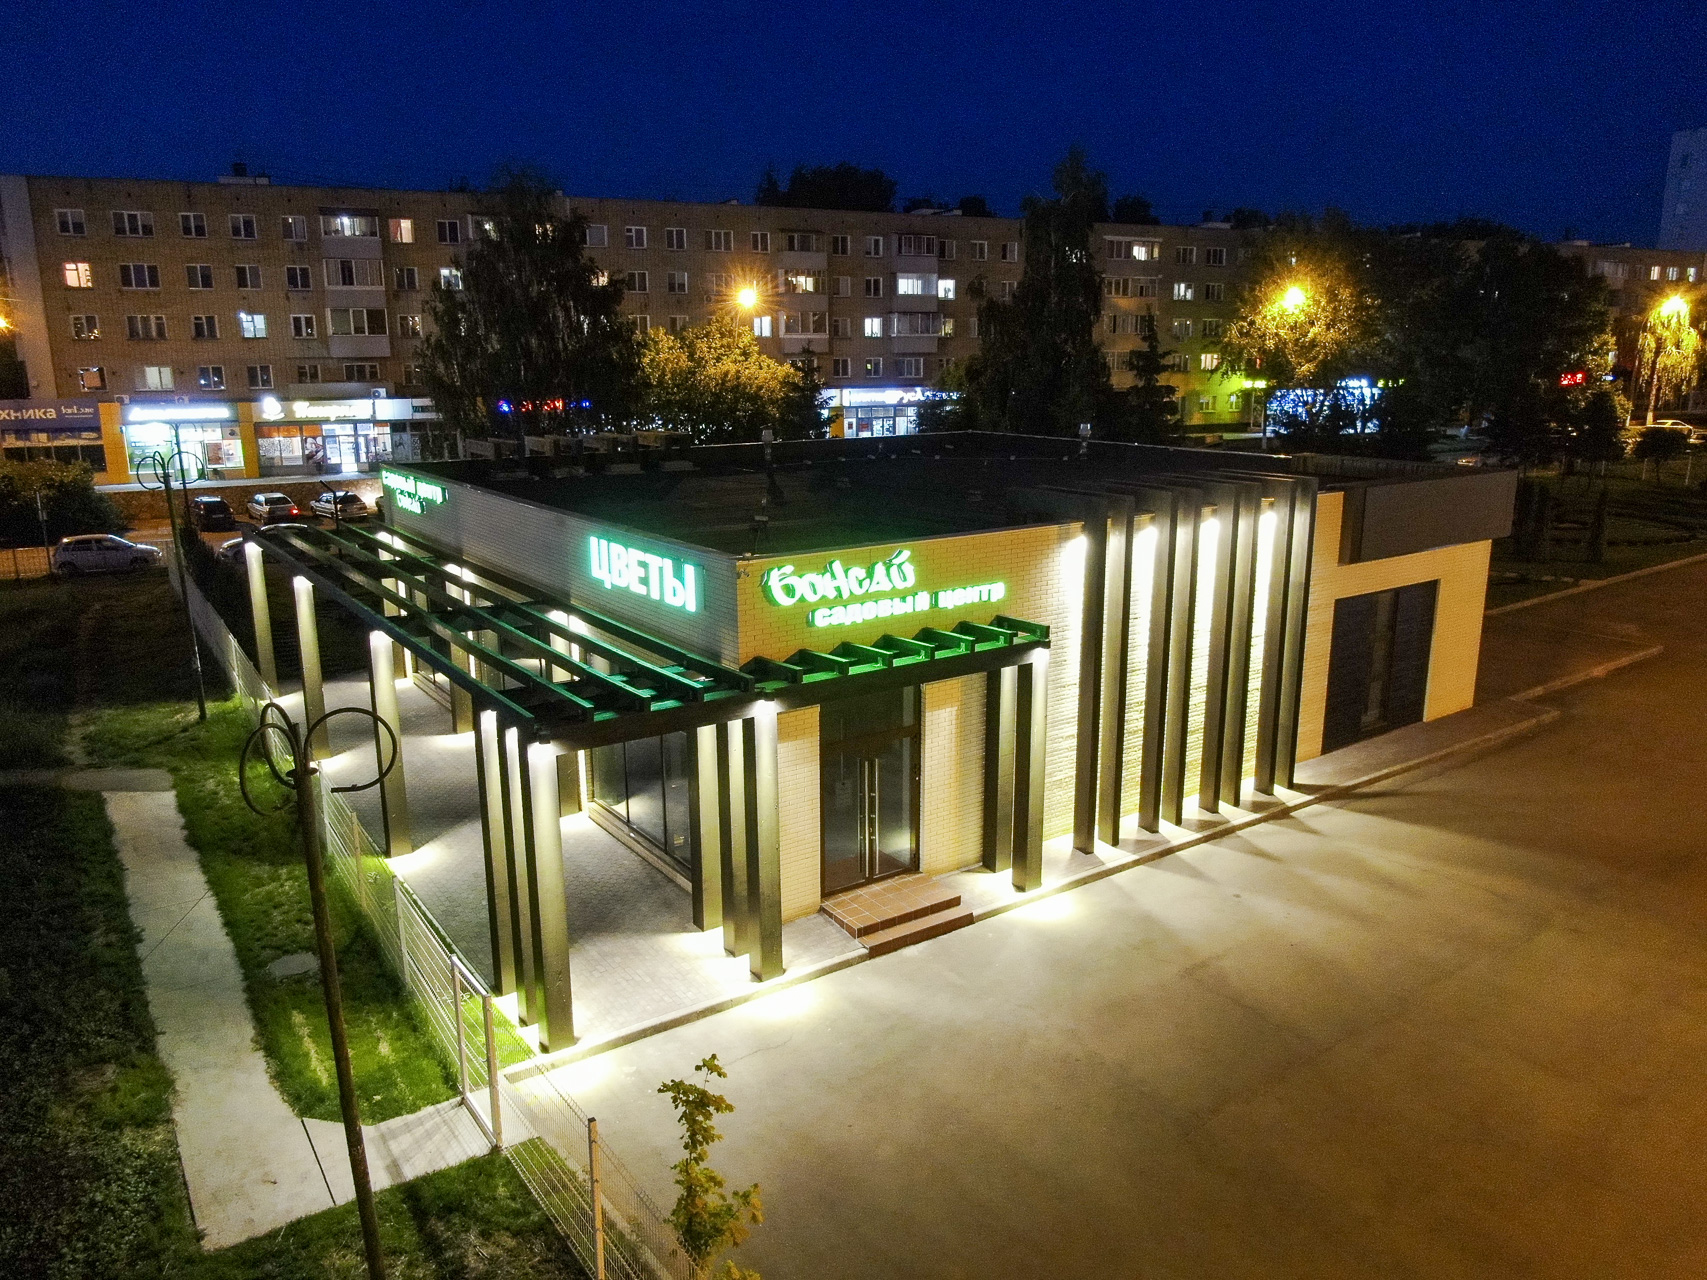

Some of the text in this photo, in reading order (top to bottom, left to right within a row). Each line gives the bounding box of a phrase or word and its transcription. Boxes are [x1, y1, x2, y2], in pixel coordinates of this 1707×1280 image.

[589, 535, 697, 610] ЦВЕТЫ
[810, 582, 1006, 628] садовый центр
